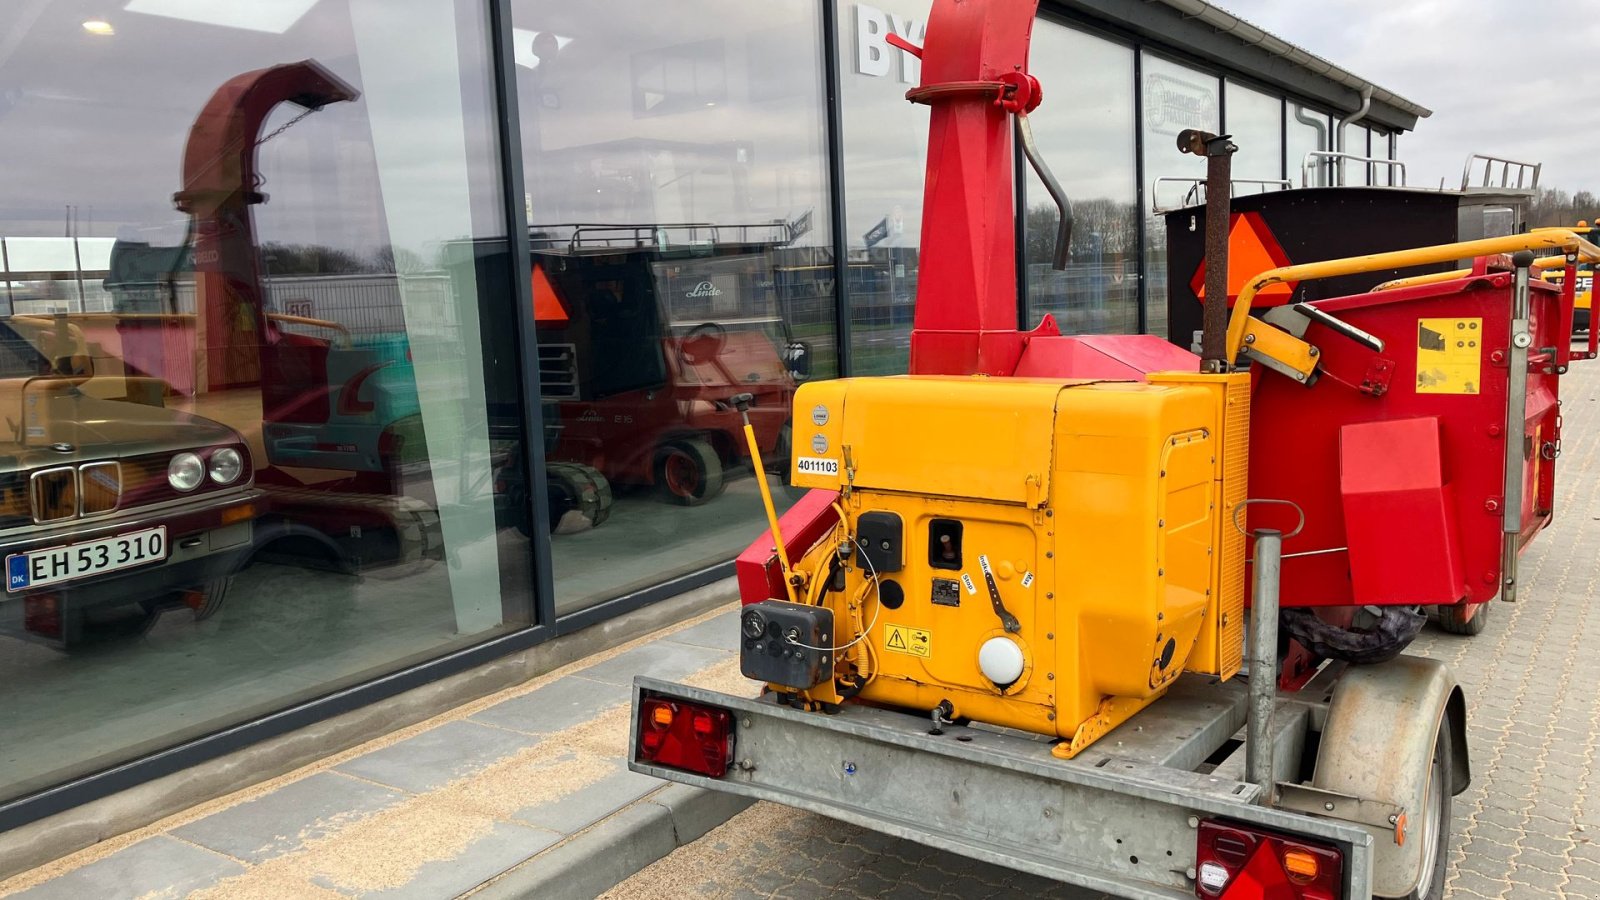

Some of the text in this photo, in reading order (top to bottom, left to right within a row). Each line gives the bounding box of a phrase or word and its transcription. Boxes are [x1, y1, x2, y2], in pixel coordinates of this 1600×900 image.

[686, 281, 722, 298] Linde
[798, 460, 838, 473] 4011103
[31, 533, 162, 581] EH 53 310
[12, 575, 24, 584] DK
[962, 574, 974, 590] Stop
